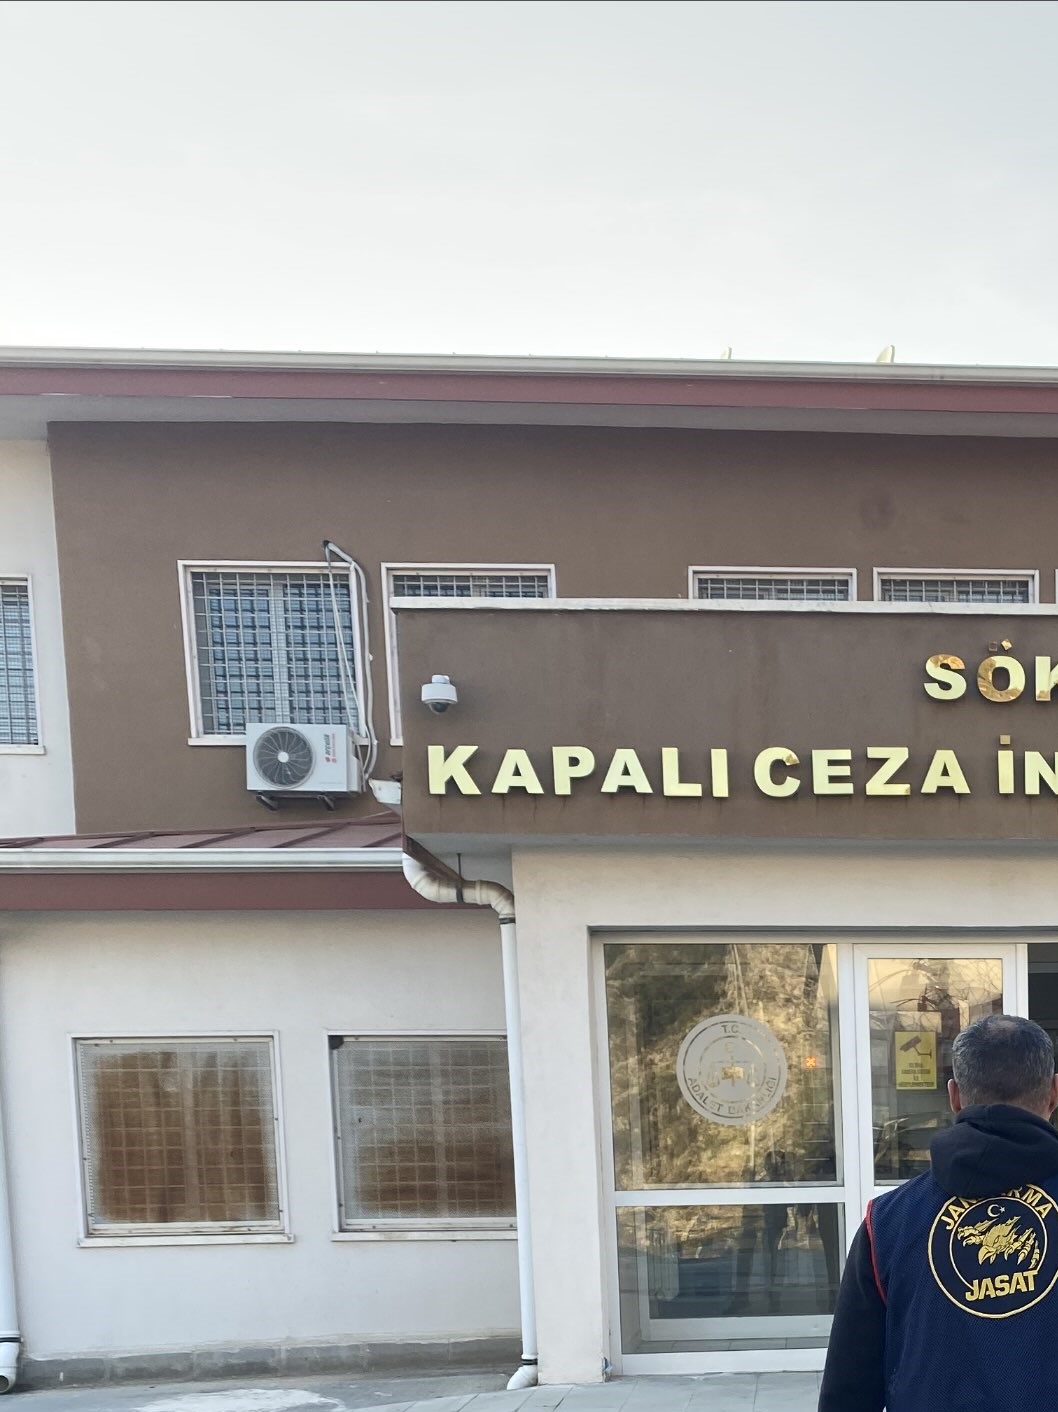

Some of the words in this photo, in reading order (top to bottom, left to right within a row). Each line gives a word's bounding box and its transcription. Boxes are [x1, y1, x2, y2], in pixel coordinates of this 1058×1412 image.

[427, 745, 729, 798] KAPALI
[753, 746, 971, 798] CEZA
[965, 1269, 1039, 1302] JASAT
